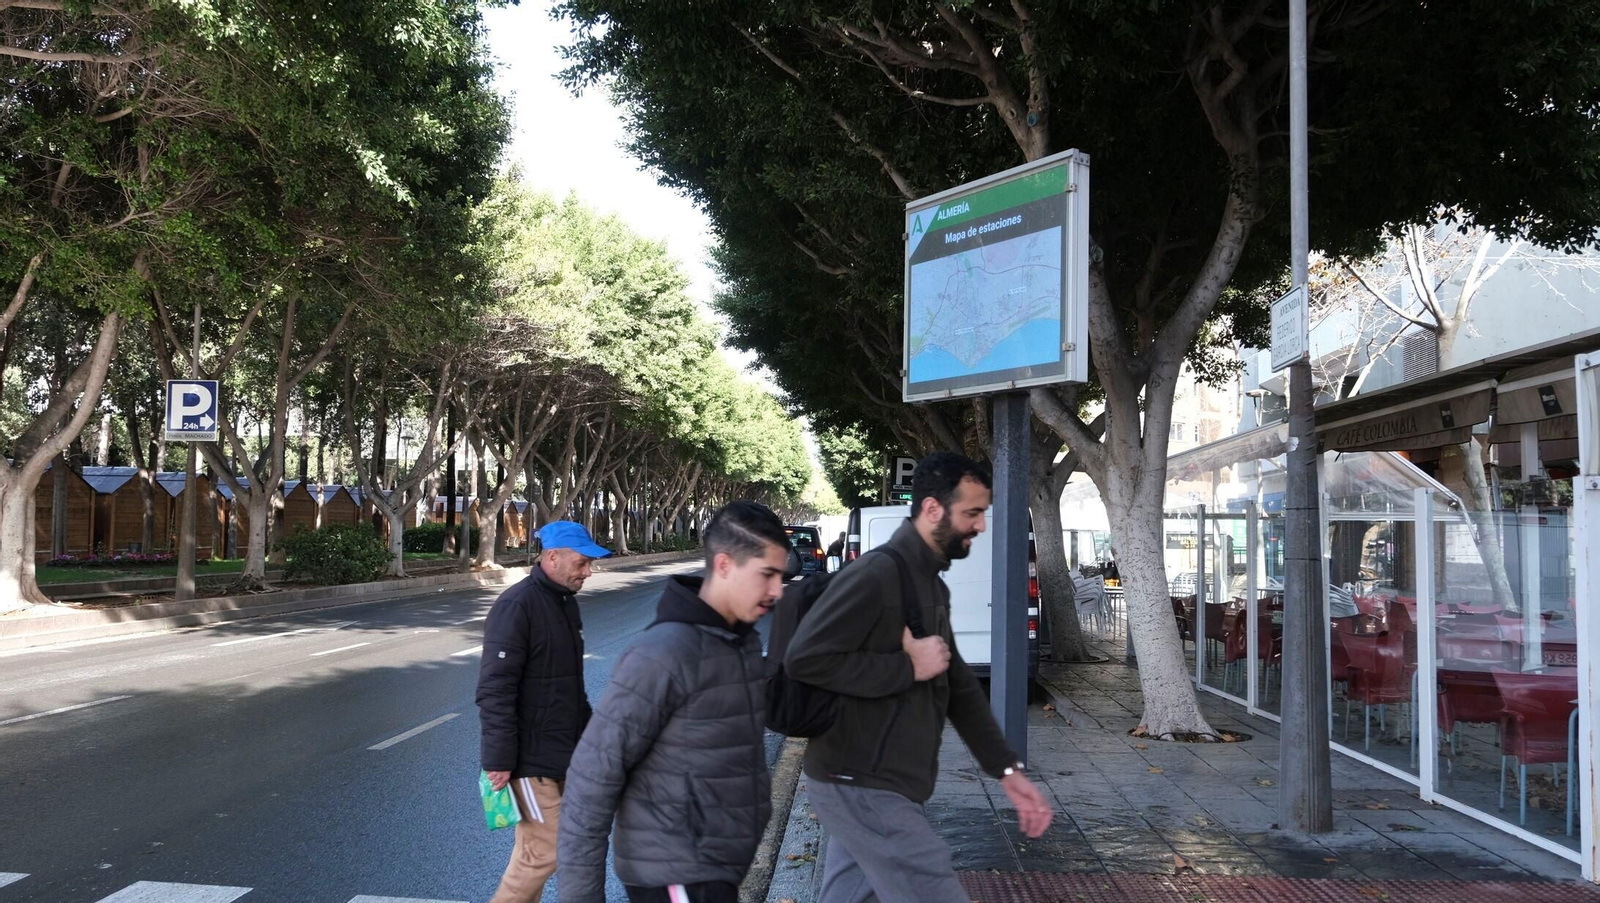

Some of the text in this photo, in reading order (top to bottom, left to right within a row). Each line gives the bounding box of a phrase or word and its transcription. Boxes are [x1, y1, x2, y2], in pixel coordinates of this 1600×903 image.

[938, 201, 970, 221] ALMERÍA
[945, 215, 1022, 244] Mapa de estaciones
[171, 384, 212, 429] P
[183, 422, 199, 430] 24h
[1363, 416, 1418, 442] COLOMBIA
[896, 457, 918, 485] P
